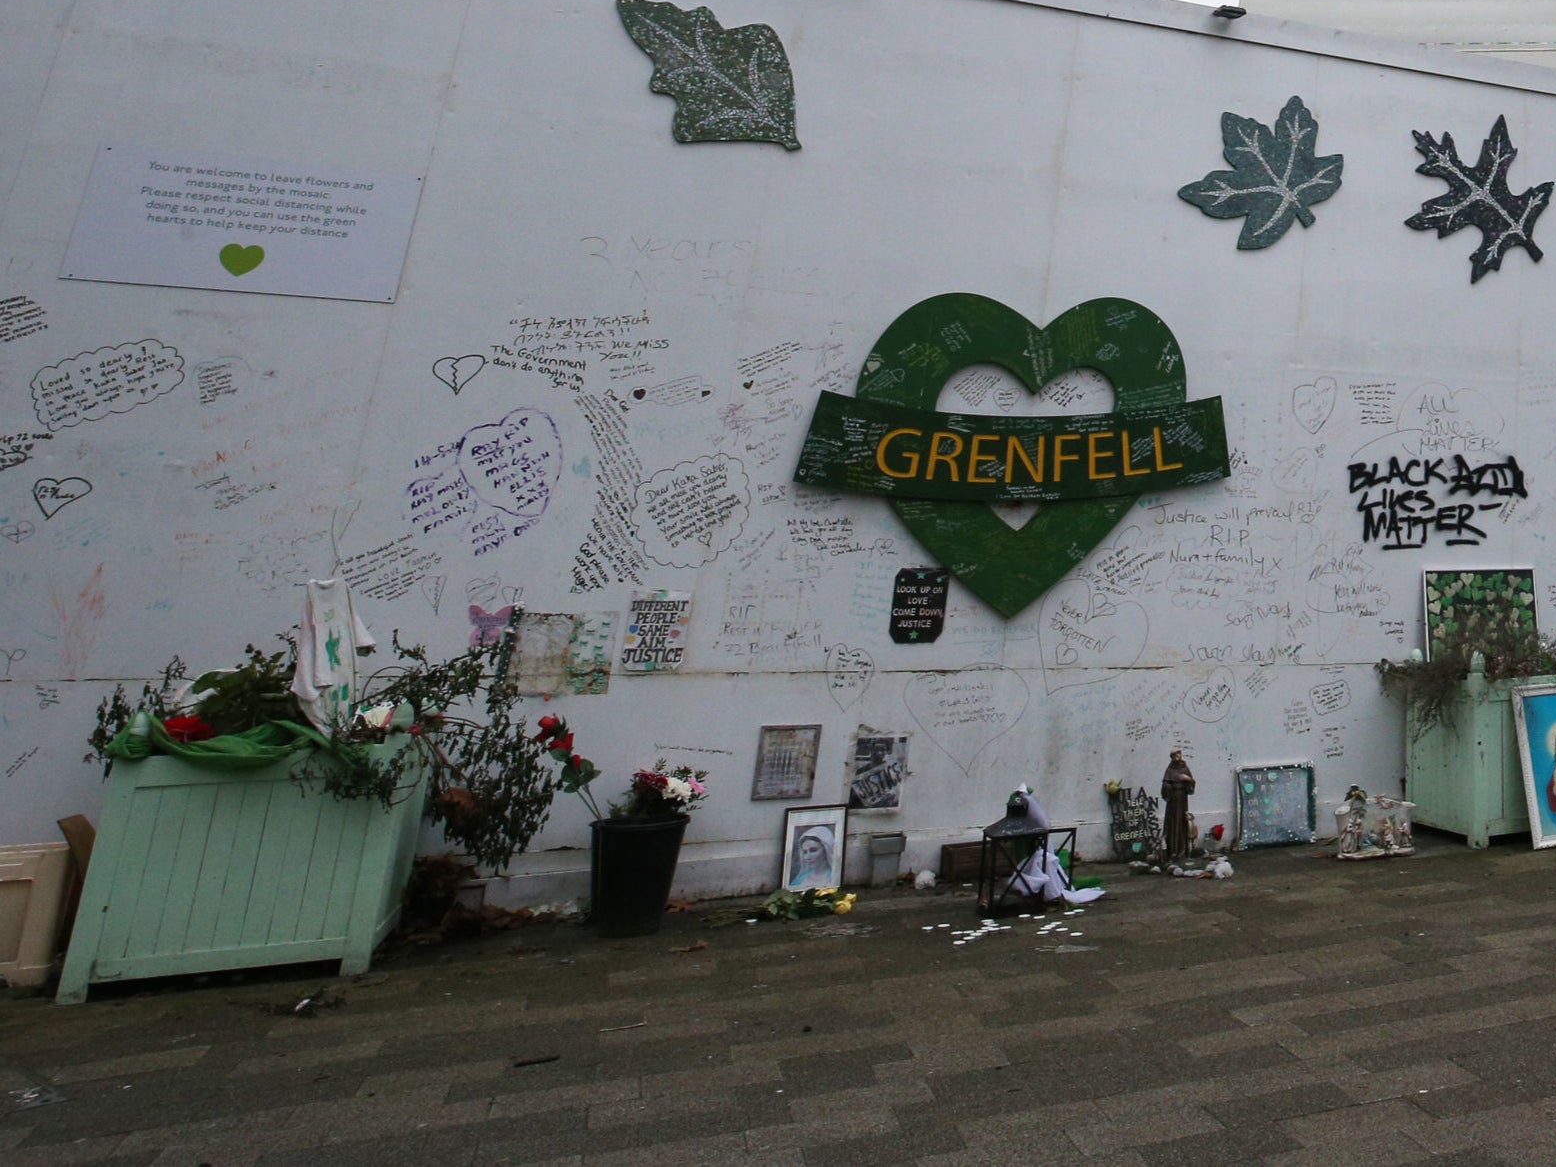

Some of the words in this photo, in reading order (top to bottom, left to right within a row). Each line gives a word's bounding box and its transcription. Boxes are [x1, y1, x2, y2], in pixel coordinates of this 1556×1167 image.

[148, 160, 170, 172] You
[172, 165, 192, 175] are
[196, 166, 252, 180] welcome
[254, 172, 268, 181] to
[270, 172, 303, 184] leave
[305, 175, 351, 189] flowers
[353, 182, 375, 192] and
[185, 178, 245, 193] messages
[247, 183, 263, 195] by
[265, 185, 286, 195] the
[288, 187, 332, 200] mosaic.
[140, 185, 183, 199] Please
[185, 191, 232, 205] respect
[235, 195, 271, 207] social
[273, 198, 334, 215] distancing
[335, 205, 368, 216] while
[145, 200, 179, 213] doing
[182, 204, 199, 215] so,
[202, 205, 226, 216] and
[227, 208, 250, 220] you
[253, 210, 274, 220] can
[277, 212, 298, 222] use
[300, 212, 321, 224] the
[322, 217, 357, 228] green
[146, 214, 187, 225] hearts
[189, 216, 204, 227] to
[206, 218, 235, 231] help
[236, 221, 267, 234] keep
[268, 223, 297, 235] your
[299, 224, 350, 239] distance
[490, 345, 514, 356] The
[517, 347, 587, 371] Government
[40, 372, 71, 391] Loved
[80, 366, 92, 375] so
[493, 357, 517, 370] don't
[521, 362, 533, 372] do
[537, 366, 585, 385] anything
[1416, 393, 1460, 415] ALL
[875, 424, 1185, 484] GRENFELL
[1418, 434, 1500, 455] MATTER
[1347, 454, 1449, 495] BLACK
[645, 485, 669, 504] Dear
[1147, 502, 1208, 525] Justice
[1214, 507, 1240, 521] will
[1245, 501, 1295, 526] prevail
[1210, 524, 1250, 548] RIP
[896, 585, 918, 594] LOOK
[920, 586, 931, 594] UP
[932, 586, 944, 594] ON
[630, 600, 690, 612] DIFFERENT
[892, 608, 917, 616] COME
[634, 612, 681, 624] PEOPLE:
[897, 620, 933, 629] JUSTICE
[637, 625, 671, 637] SAME
[1050, 611, 1117, 654] FORGOTTEN
[621, 648, 685, 664] JUSTICE
[1122, 808, 1147, 818] THEM
[1127, 799, 1145, 808] TELL
[1128, 819, 1140, 828] OF
[1114, 829, 1153, 842] GRENFELL
